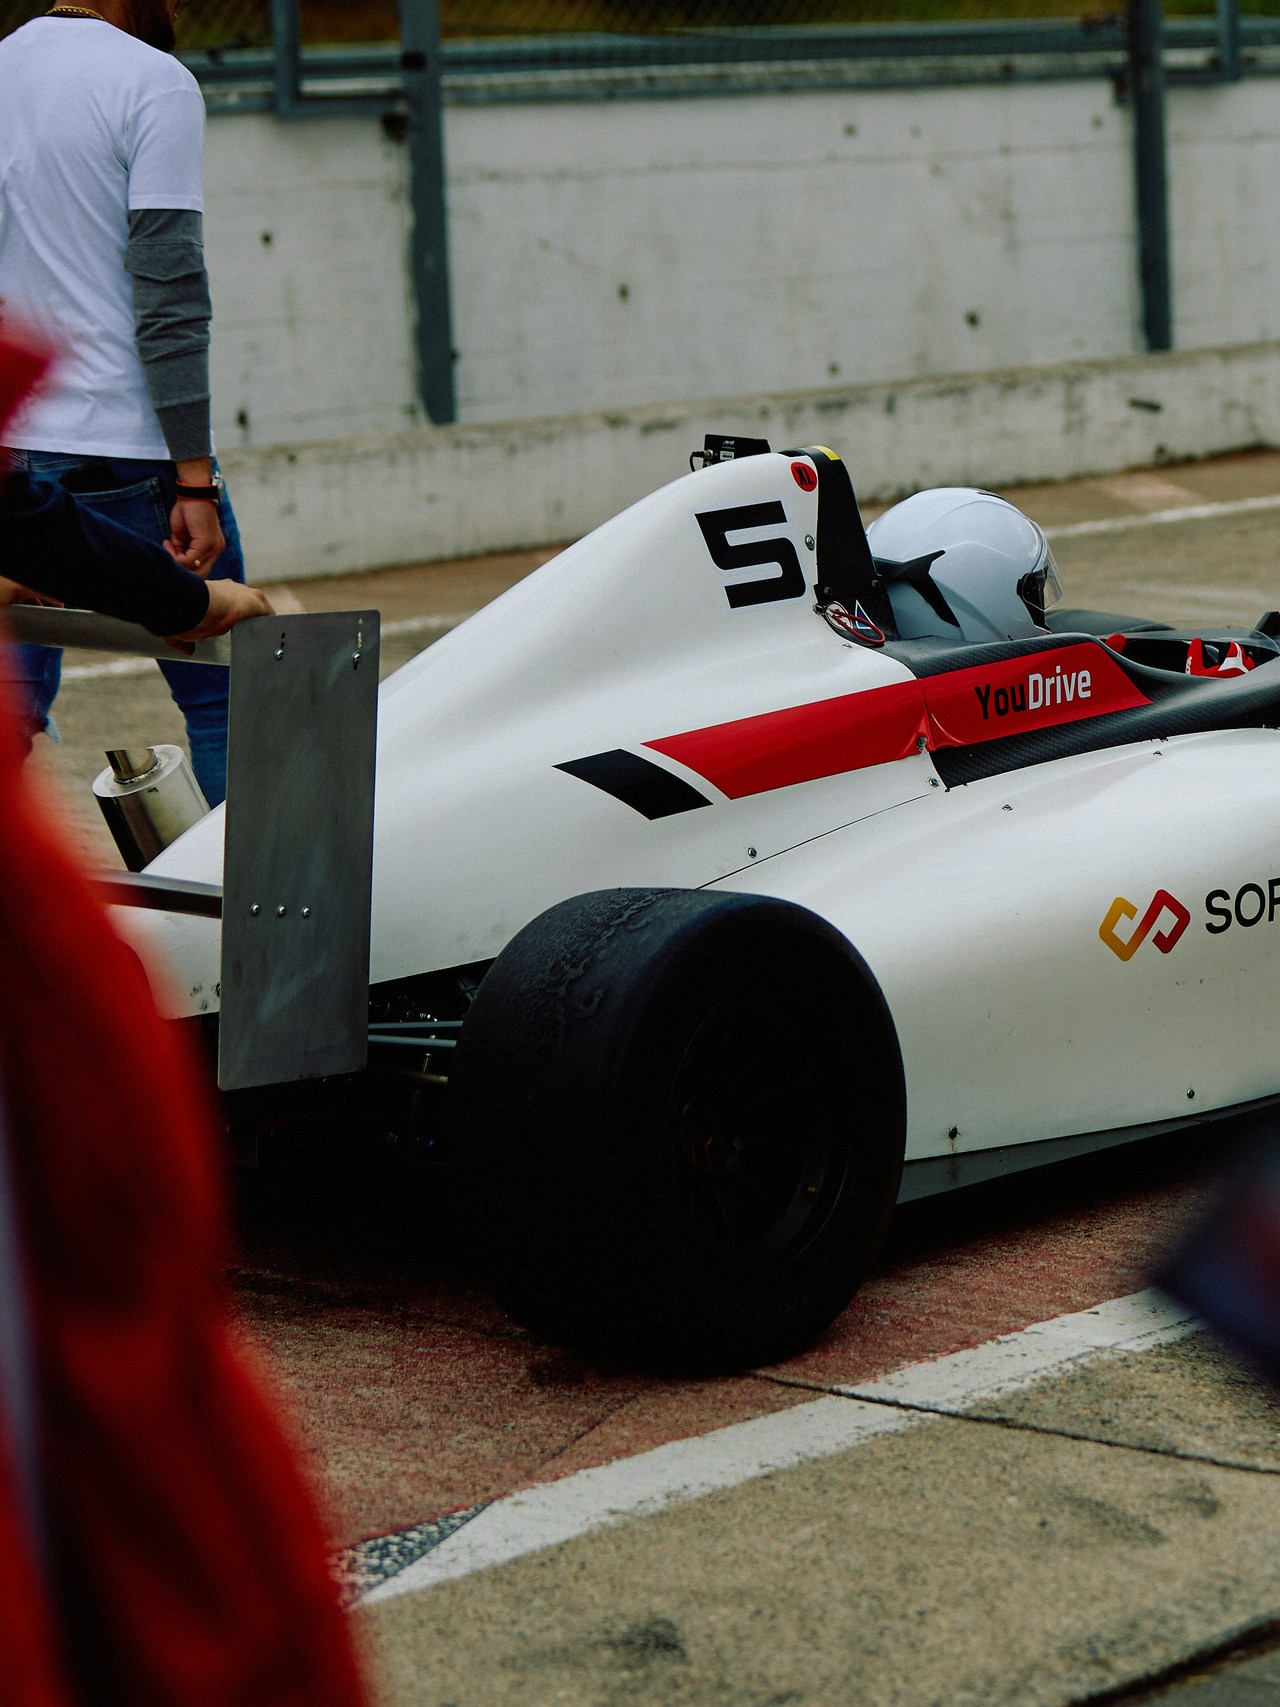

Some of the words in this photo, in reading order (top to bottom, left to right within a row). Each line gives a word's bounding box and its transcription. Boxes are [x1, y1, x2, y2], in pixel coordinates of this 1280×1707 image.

[794, 466, 814, 485] XL
[695, 500, 806, 609] 5
[974, 665, 1091, 720] YouDrive
